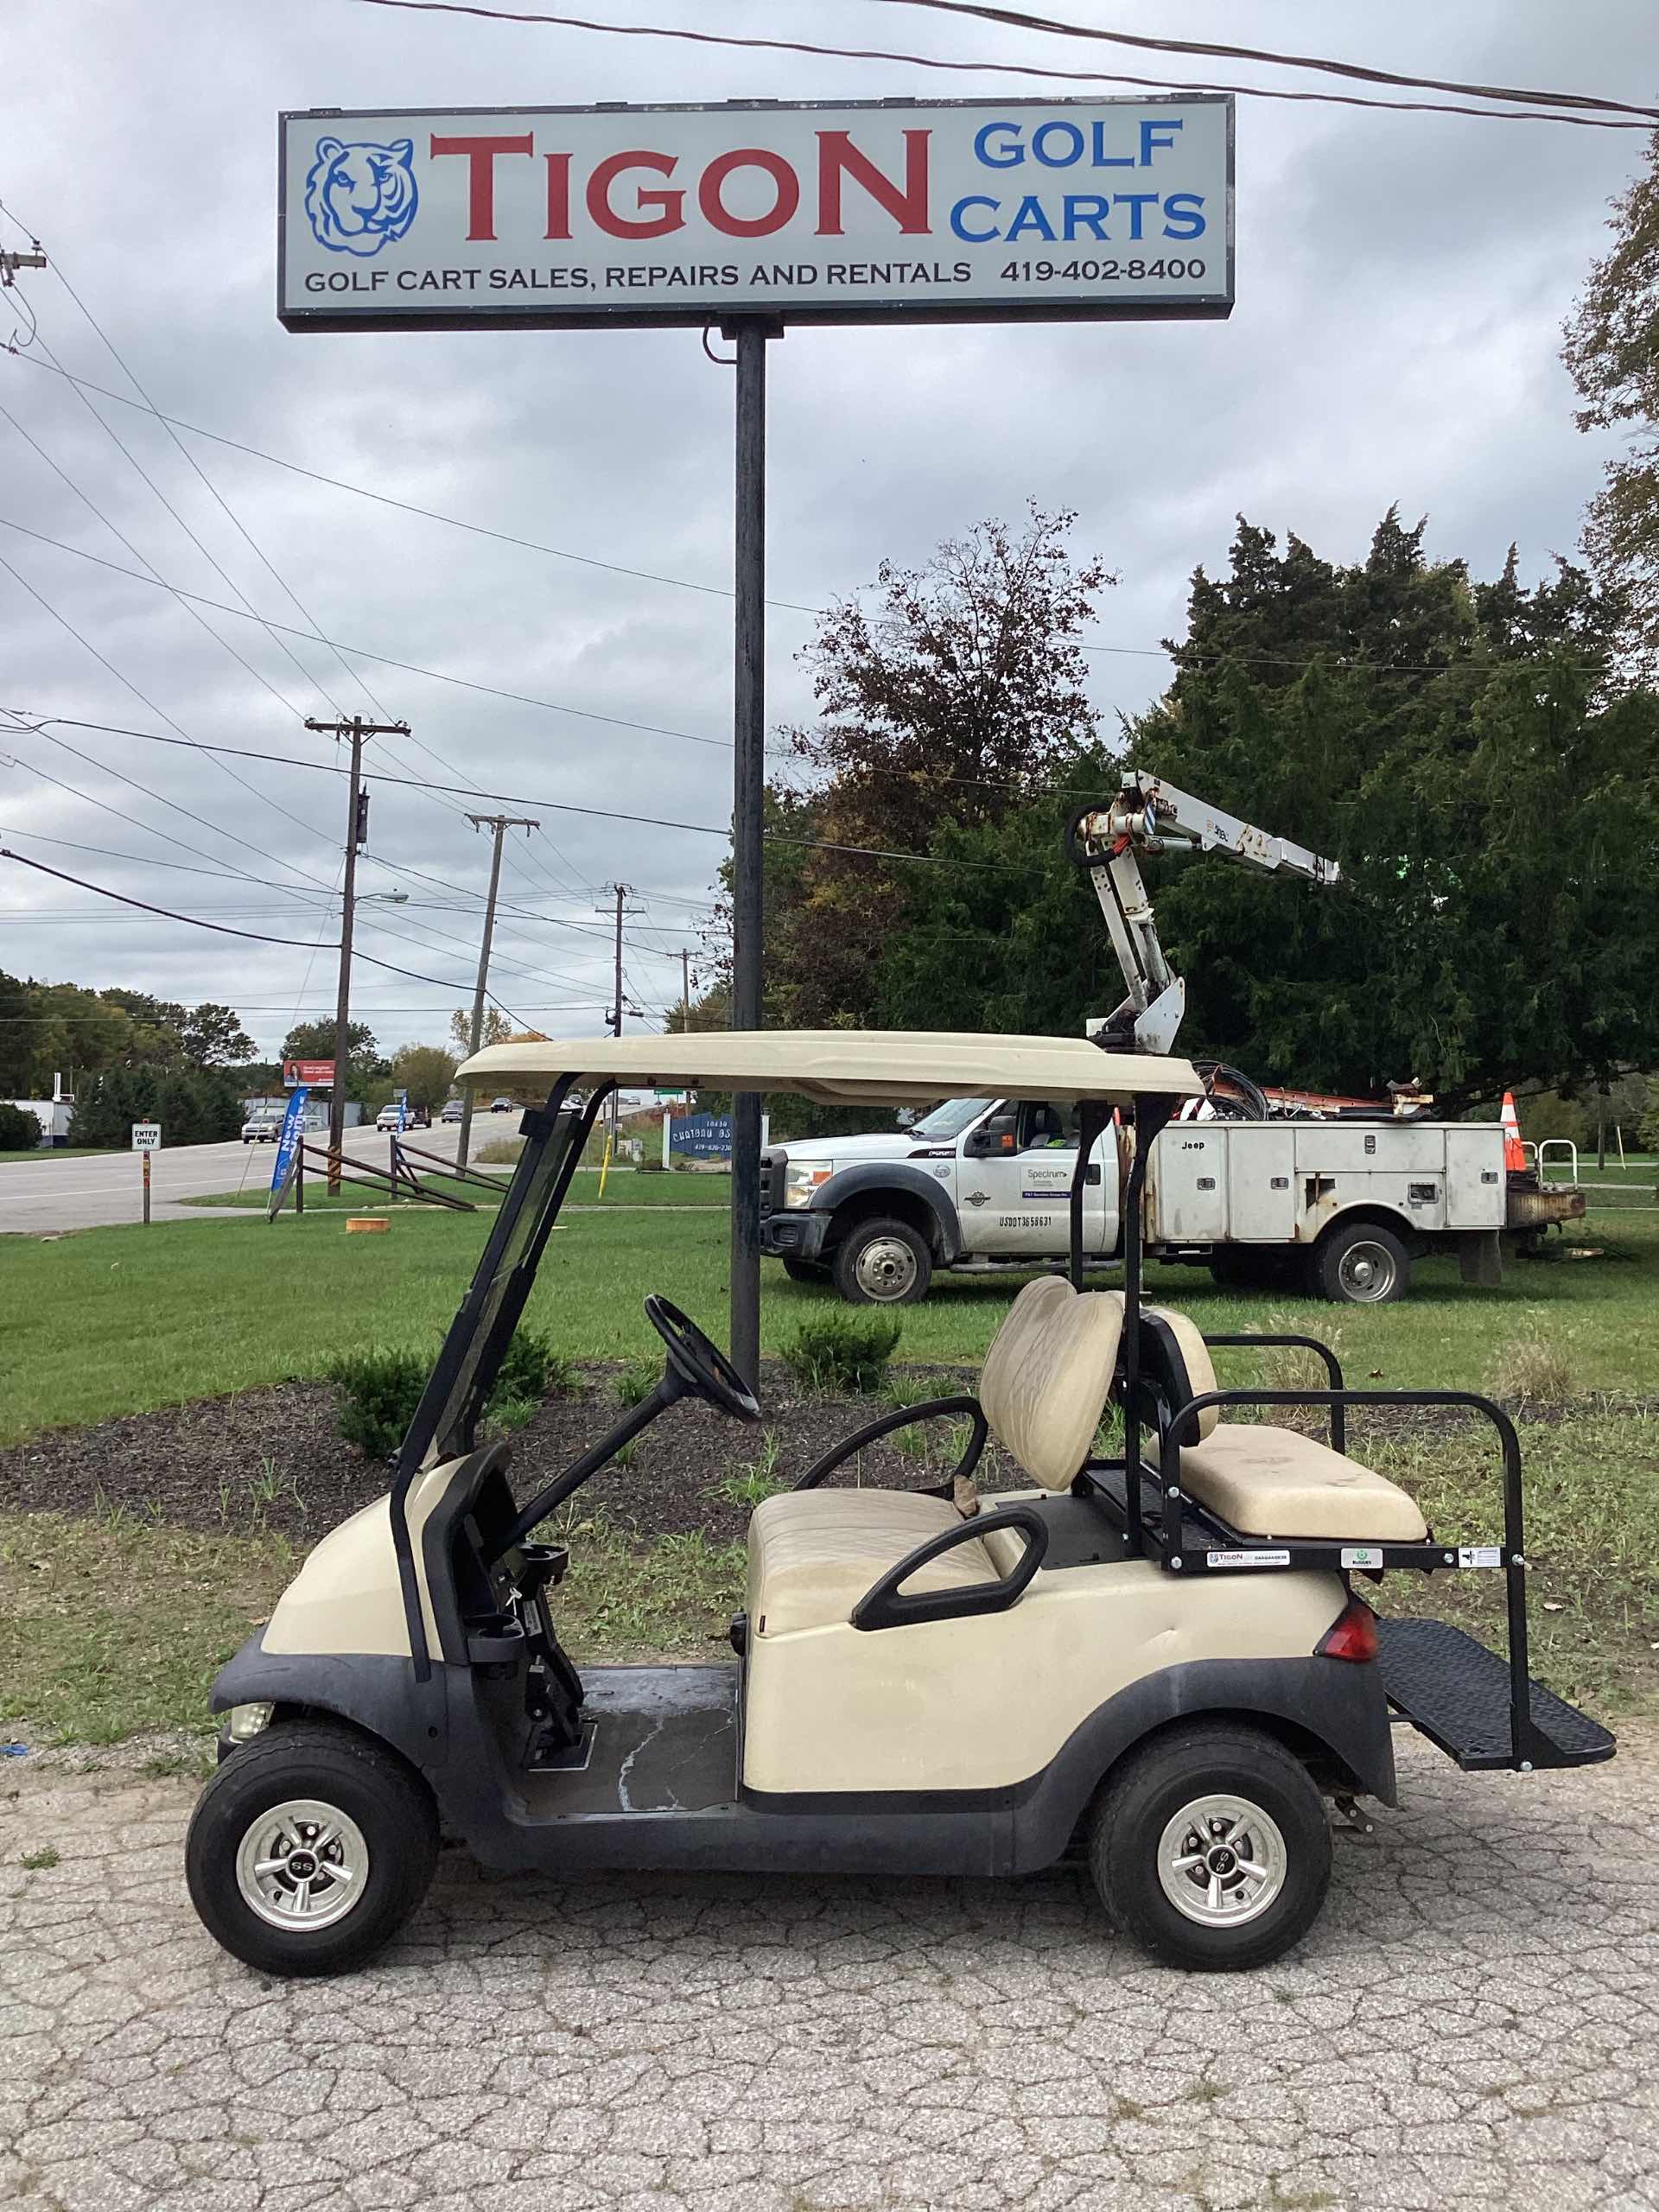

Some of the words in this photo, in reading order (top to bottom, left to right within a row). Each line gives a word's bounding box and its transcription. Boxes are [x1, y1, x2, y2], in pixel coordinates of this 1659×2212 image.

[974, 118, 1183, 168] GOLF
[430, 130, 933, 241] TIGON
[950, 193, 1206, 243] CARTS
[304, 270, 388, 292] GOLF
[397, 270, 481, 290] CART
[489, 268, 596, 292] SALES,
[606, 265, 739, 288] REPAIRS
[750, 264, 817, 285] AND
[827, 262, 972, 284] RENTALS
[1001, 259, 1206, 282] 419-402-8400
[1181, 1141, 1205, 1150] Jeep
[1027, 1169, 1065, 1179] Spectrum
[291, 1861, 313, 1871] SS
[1216, 1851, 1229, 1872] SS
